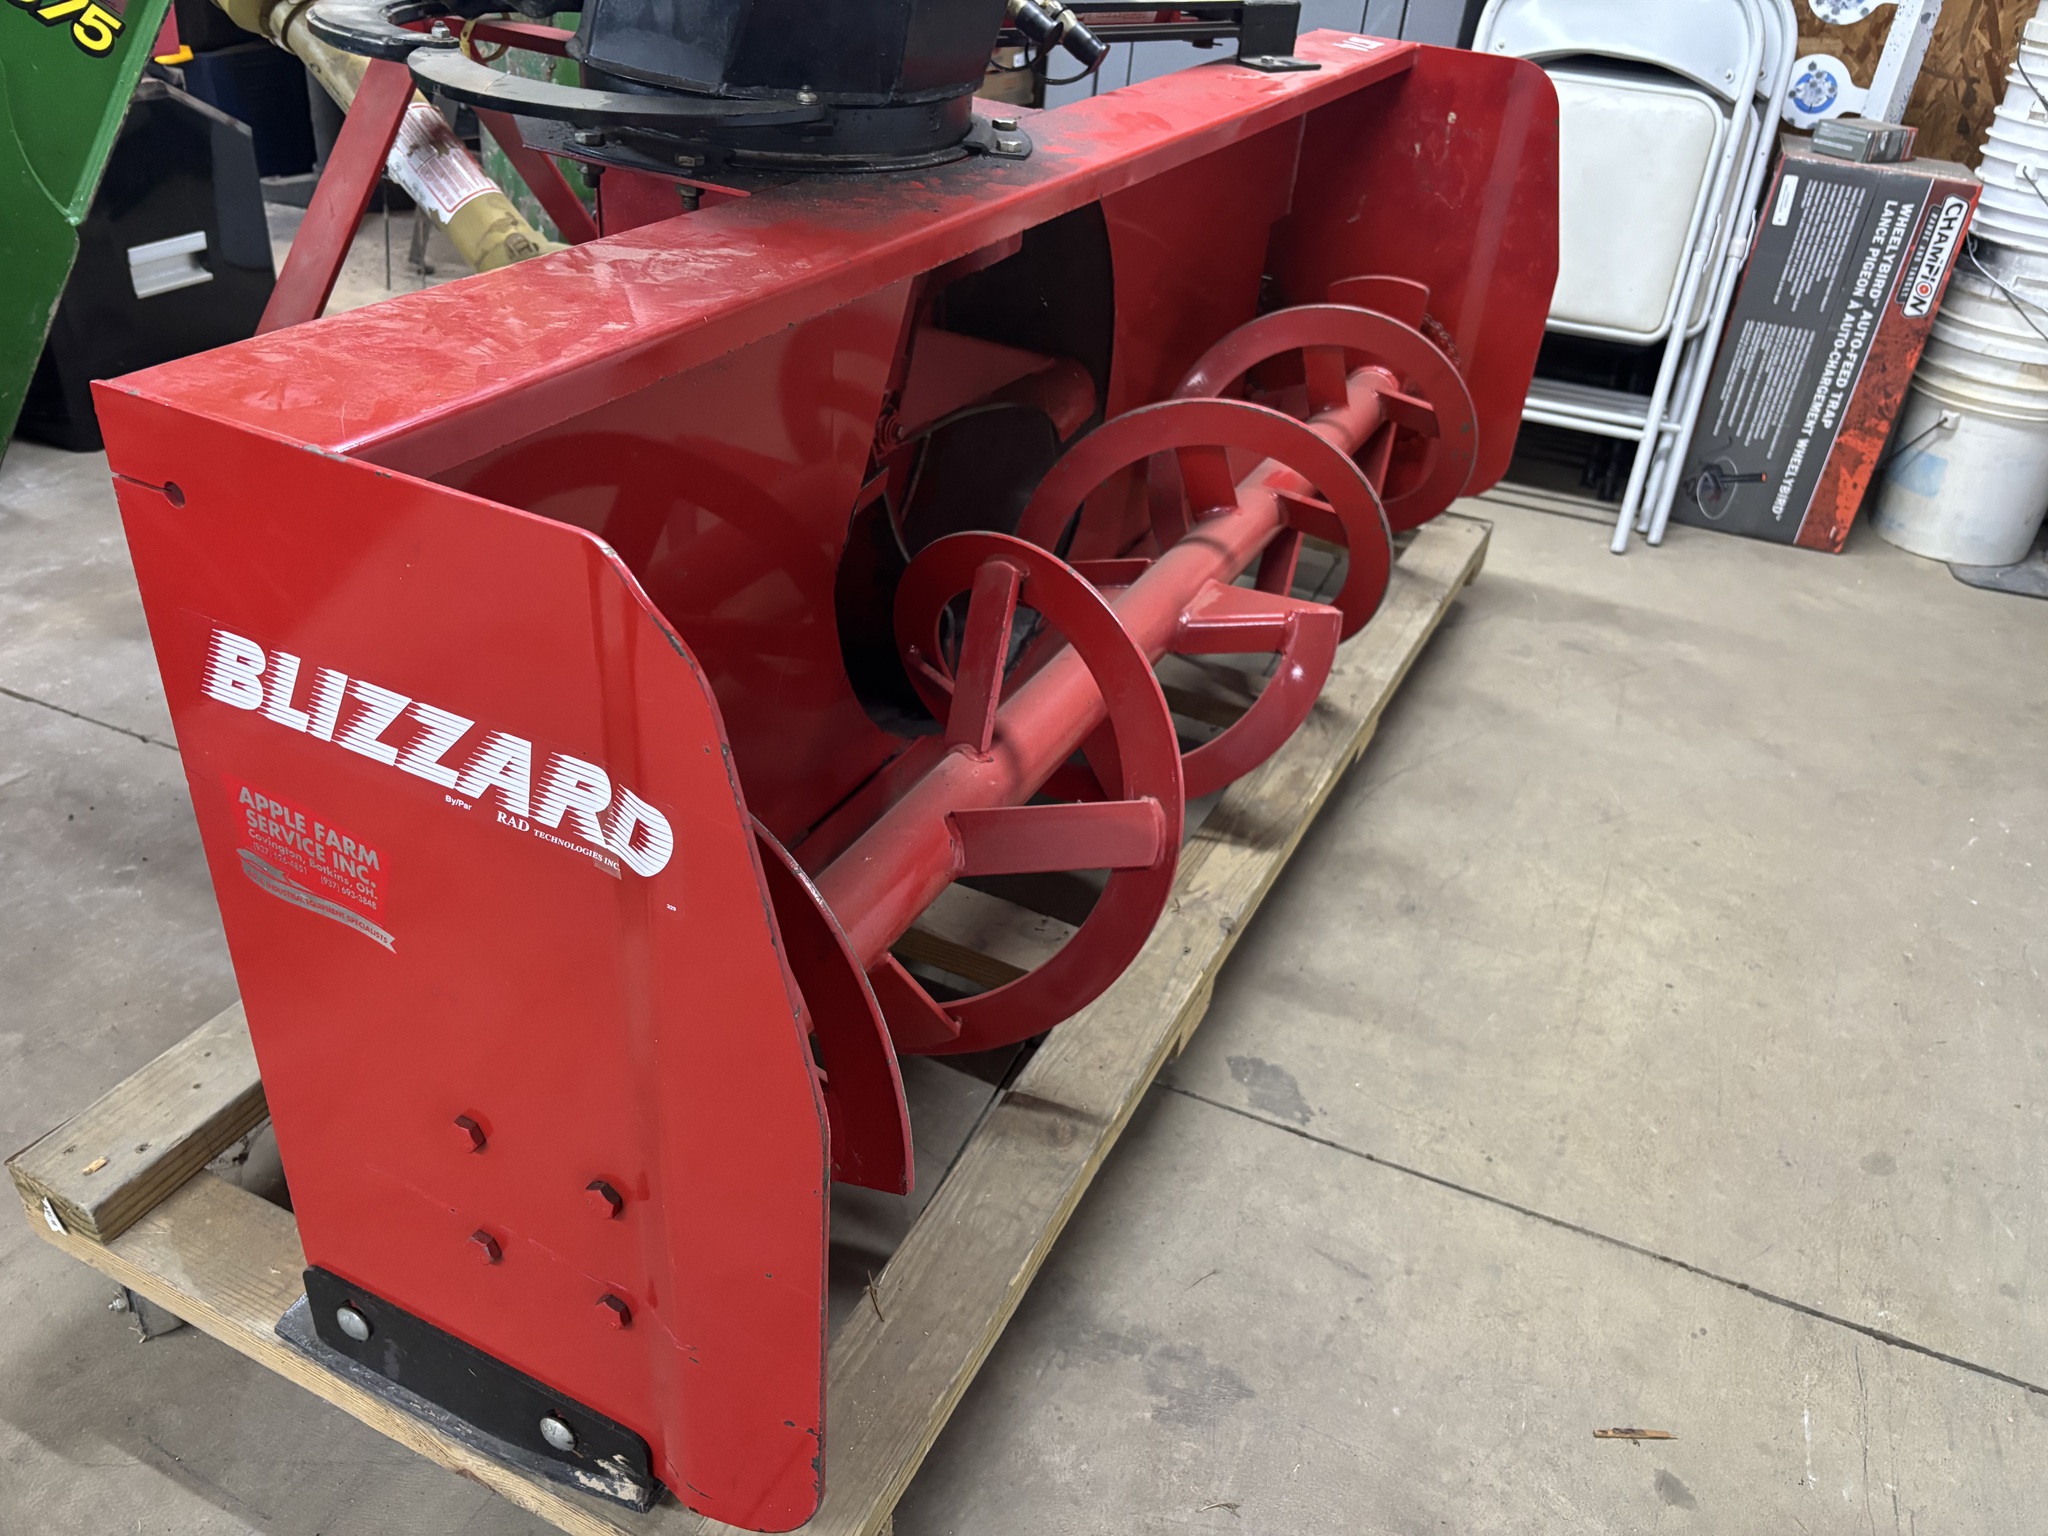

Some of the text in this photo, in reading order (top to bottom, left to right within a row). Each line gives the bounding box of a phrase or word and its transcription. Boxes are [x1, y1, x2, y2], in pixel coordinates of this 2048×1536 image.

[18, 0, 123, 53] 75
[1872, 200, 1899, 245] LANCE
[1852, 247, 1881, 297] PIGEON
[1909, 203, 1964, 315] CHAMPION
[1801, 312, 1856, 437] AUTO-CHARGEMENT
[1835, 309, 1874, 389] AUTO-FEED
[1821, 391, 1844, 430] TRAP
[201, 628, 674, 878] BLIZZARD
[239, 786, 380, 871] APPLE FARM
[445, 794, 472, 811] By/Par
[245, 808, 377, 889] SERVICE INC.
[248, 828, 378, 900] Covington, Botkins, OH.
[496, 810, 621, 872] RAD TECHNOLOGIES INC.
[346, 915, 389, 945] SPECIALISTS
